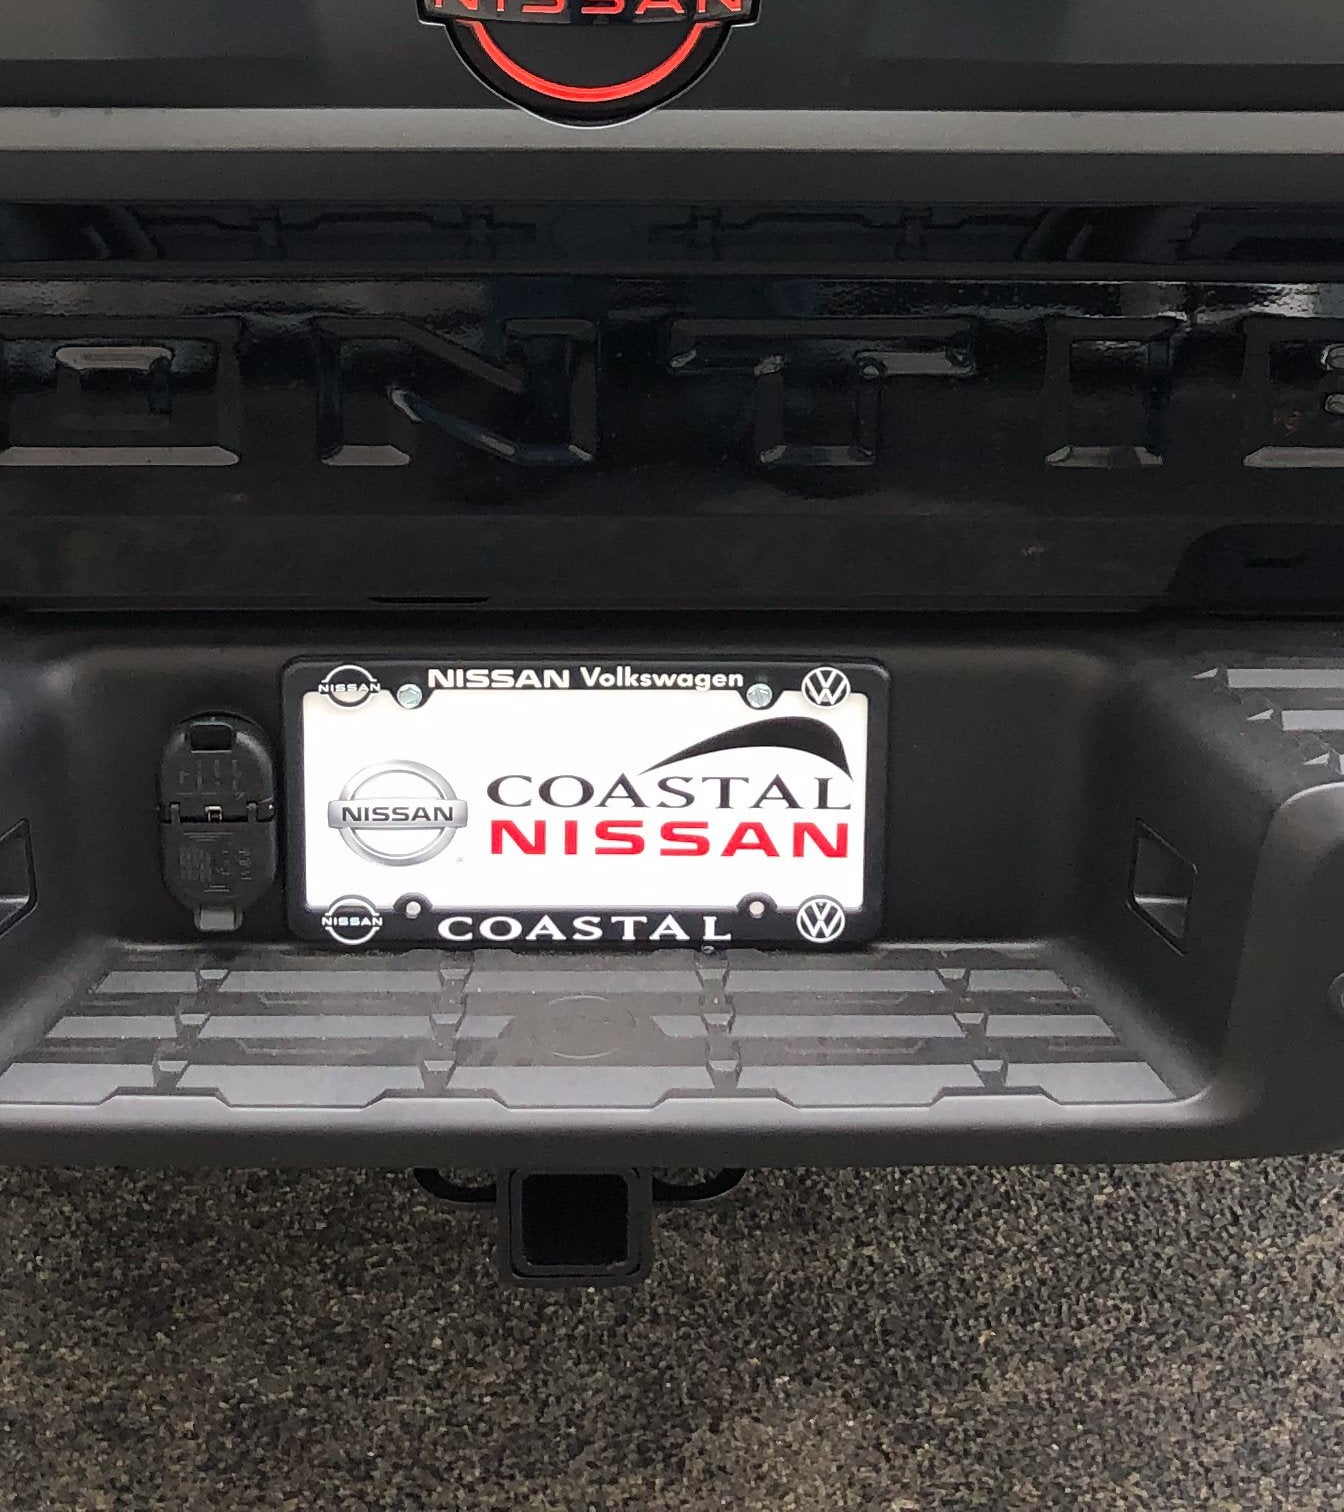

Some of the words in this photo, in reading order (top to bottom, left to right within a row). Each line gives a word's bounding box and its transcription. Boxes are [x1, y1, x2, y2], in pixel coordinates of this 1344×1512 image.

[317, 682, 381, 694] NISSAN
[427, 668, 571, 689] NISSAN
[579, 665, 744, 692] Volkswagen
[486, 773, 852, 810] COASTAL
[341, 806, 454, 823] NISSAN
[490, 819, 849, 858] NISSAN
[320, 915, 384, 927] NISSAN
[436, 913, 732, 942] COASTAL
